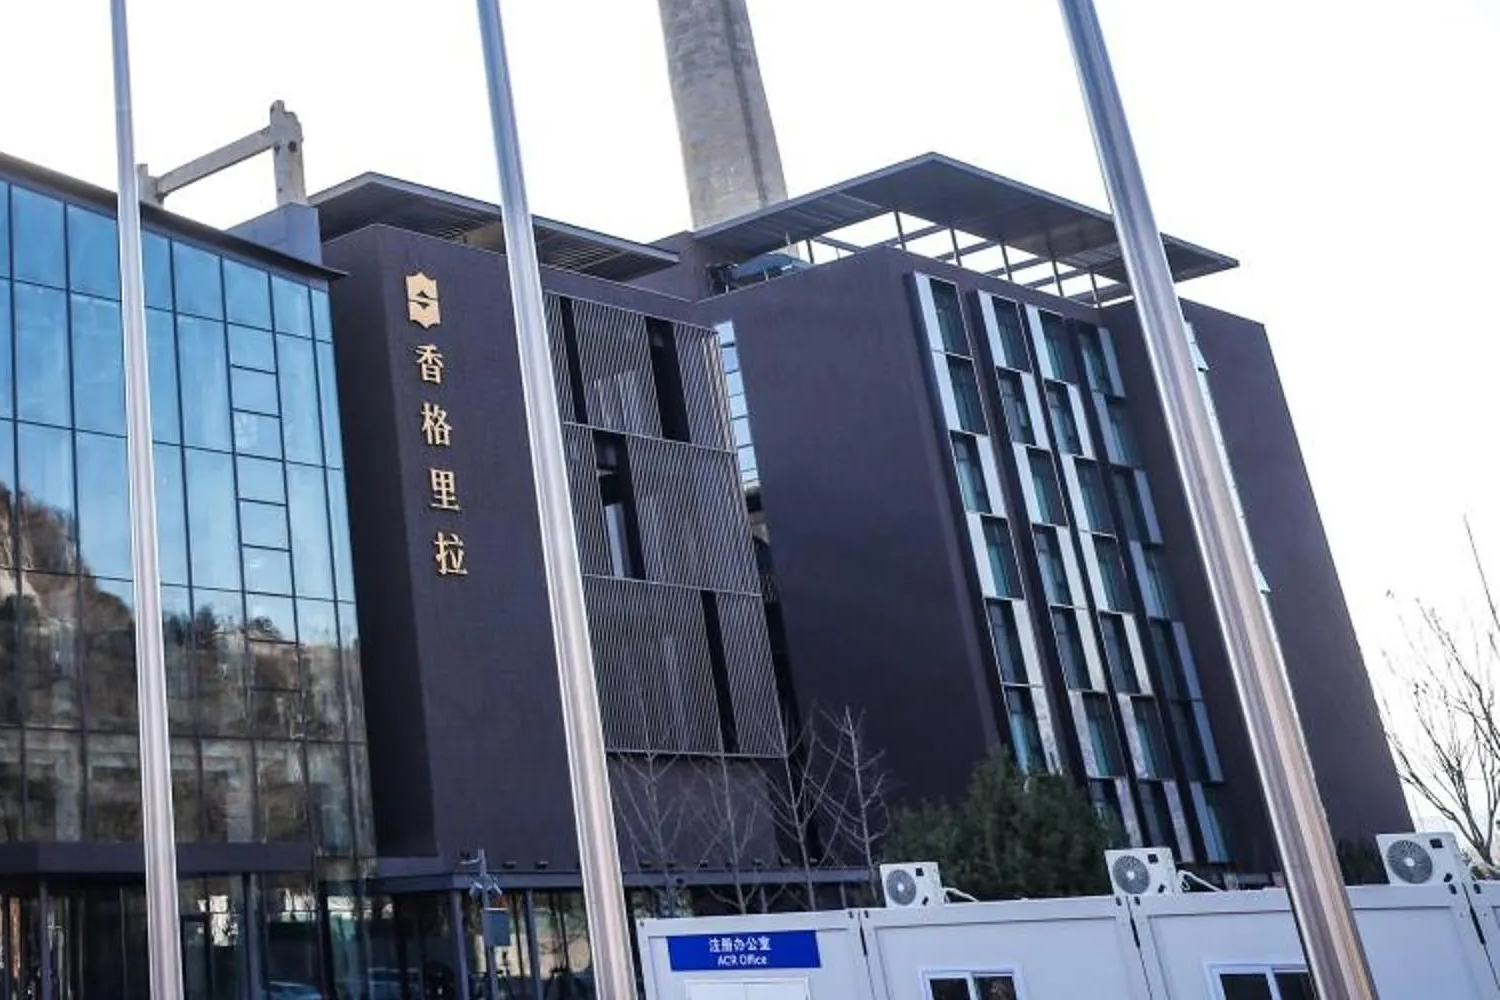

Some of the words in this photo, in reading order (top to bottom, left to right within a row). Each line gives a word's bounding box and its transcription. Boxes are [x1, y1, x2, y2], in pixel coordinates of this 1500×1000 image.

[415, 343, 468, 576] 香格里拉
[708, 936, 772, 953] 注册办公室
[717, 954, 738, 967] ACR
[739, 953, 767, 967] Office
